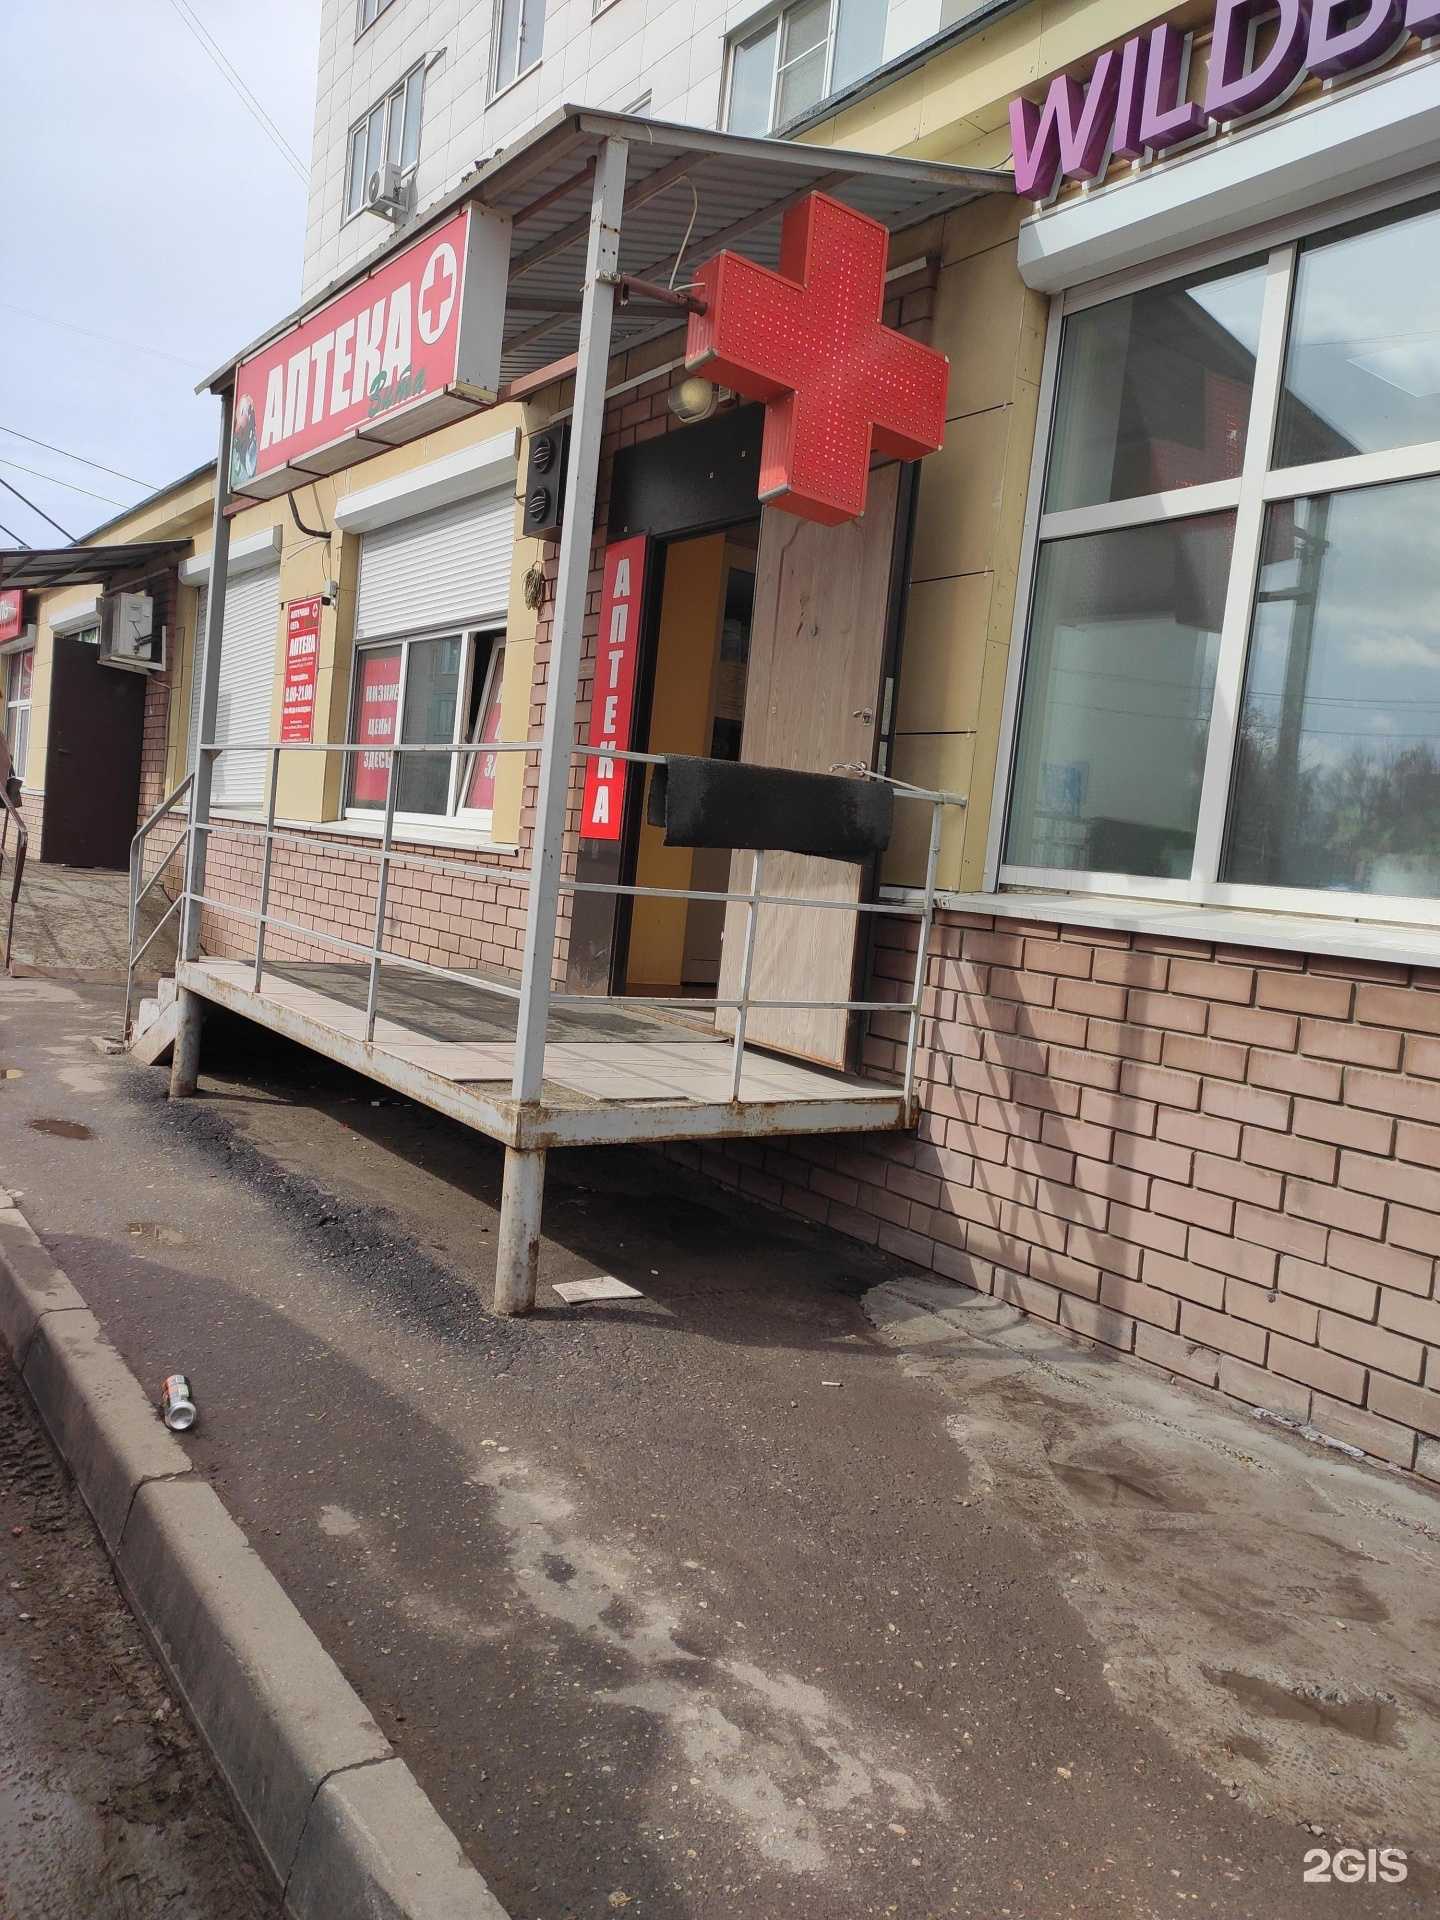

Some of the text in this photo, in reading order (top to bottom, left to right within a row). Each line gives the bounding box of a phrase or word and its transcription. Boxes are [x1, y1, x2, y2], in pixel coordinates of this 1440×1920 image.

[260, 281, 412, 451] АПТЕКА
[289, 634, 316, 657] АПТЕКА
[591, 558, 631, 824] АПТЕКА
[367, 718, 392, 736] ЦЕНЫ
